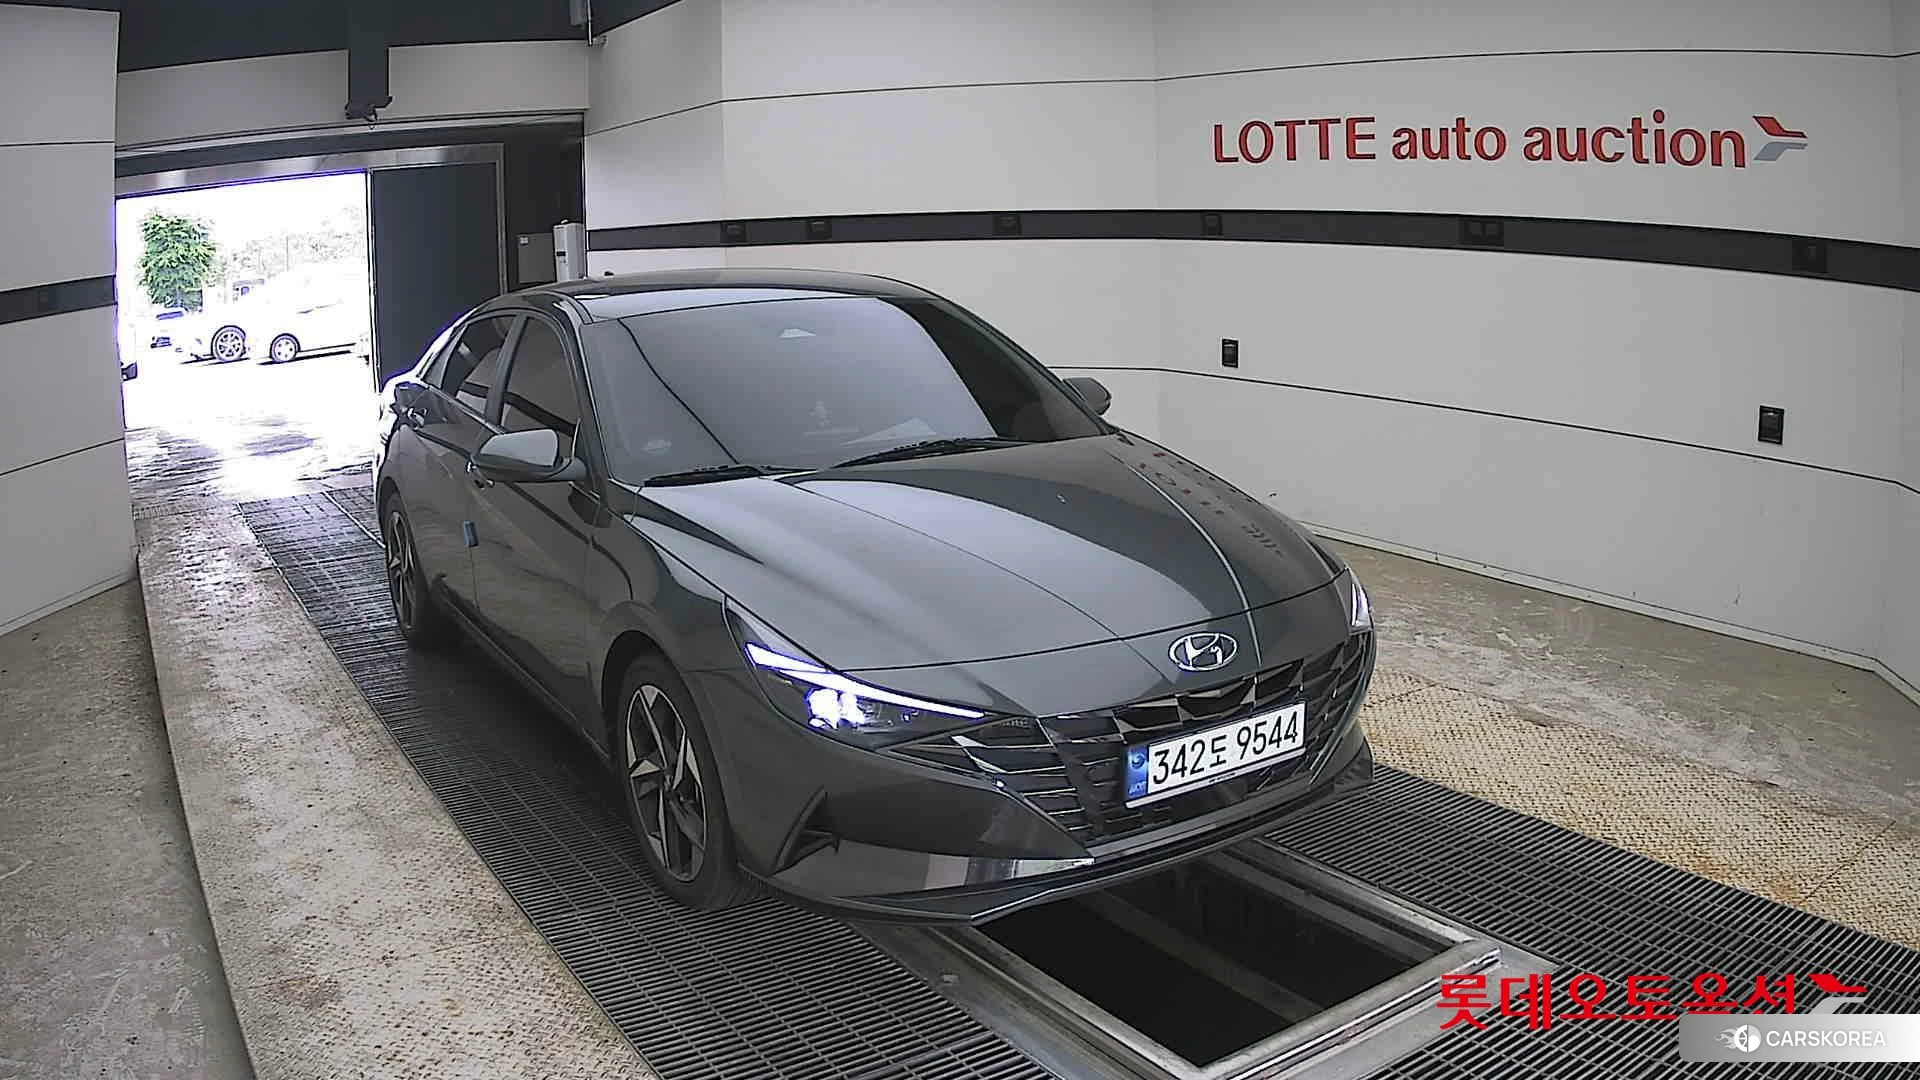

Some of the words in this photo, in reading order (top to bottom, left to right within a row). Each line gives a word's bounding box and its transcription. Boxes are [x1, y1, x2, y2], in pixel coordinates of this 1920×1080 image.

[1213, 116, 1377, 164] LOTTE
[1391, 116, 1508, 162] auto
[1522, 108, 1747, 168] auction
[1152, 734, 1228, 785] 342도
[1236, 710, 1299, 761] 9544
